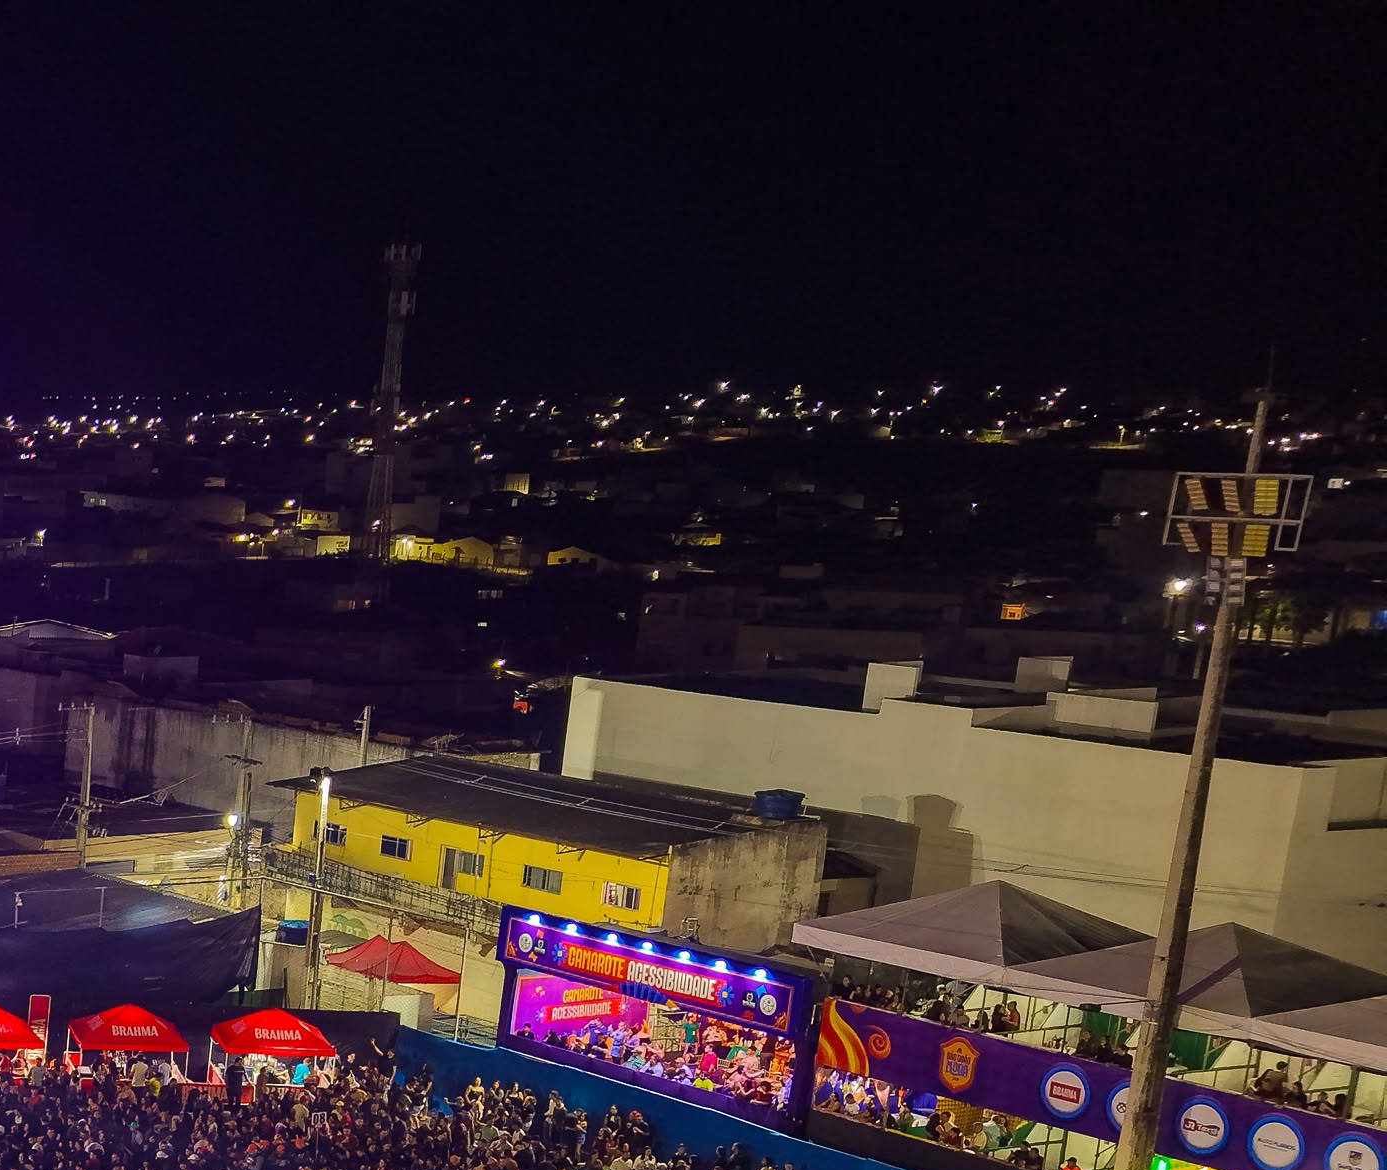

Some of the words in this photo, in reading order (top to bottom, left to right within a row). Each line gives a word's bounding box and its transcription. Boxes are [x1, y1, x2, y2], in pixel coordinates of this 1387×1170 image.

[567, 946, 625, 979] CAMAROTE
[627, 960, 717, 1001] ACESSIBILIDADE
[562, 986, 604, 1003] CAMAROTE
[551, 1001, 613, 1021] ACESSIBILIDADE
[111, 1024, 159, 1037] BRAHMA
[254, 1027, 302, 1041] BRAHMA
[313, 1112, 326, 1125] 08
